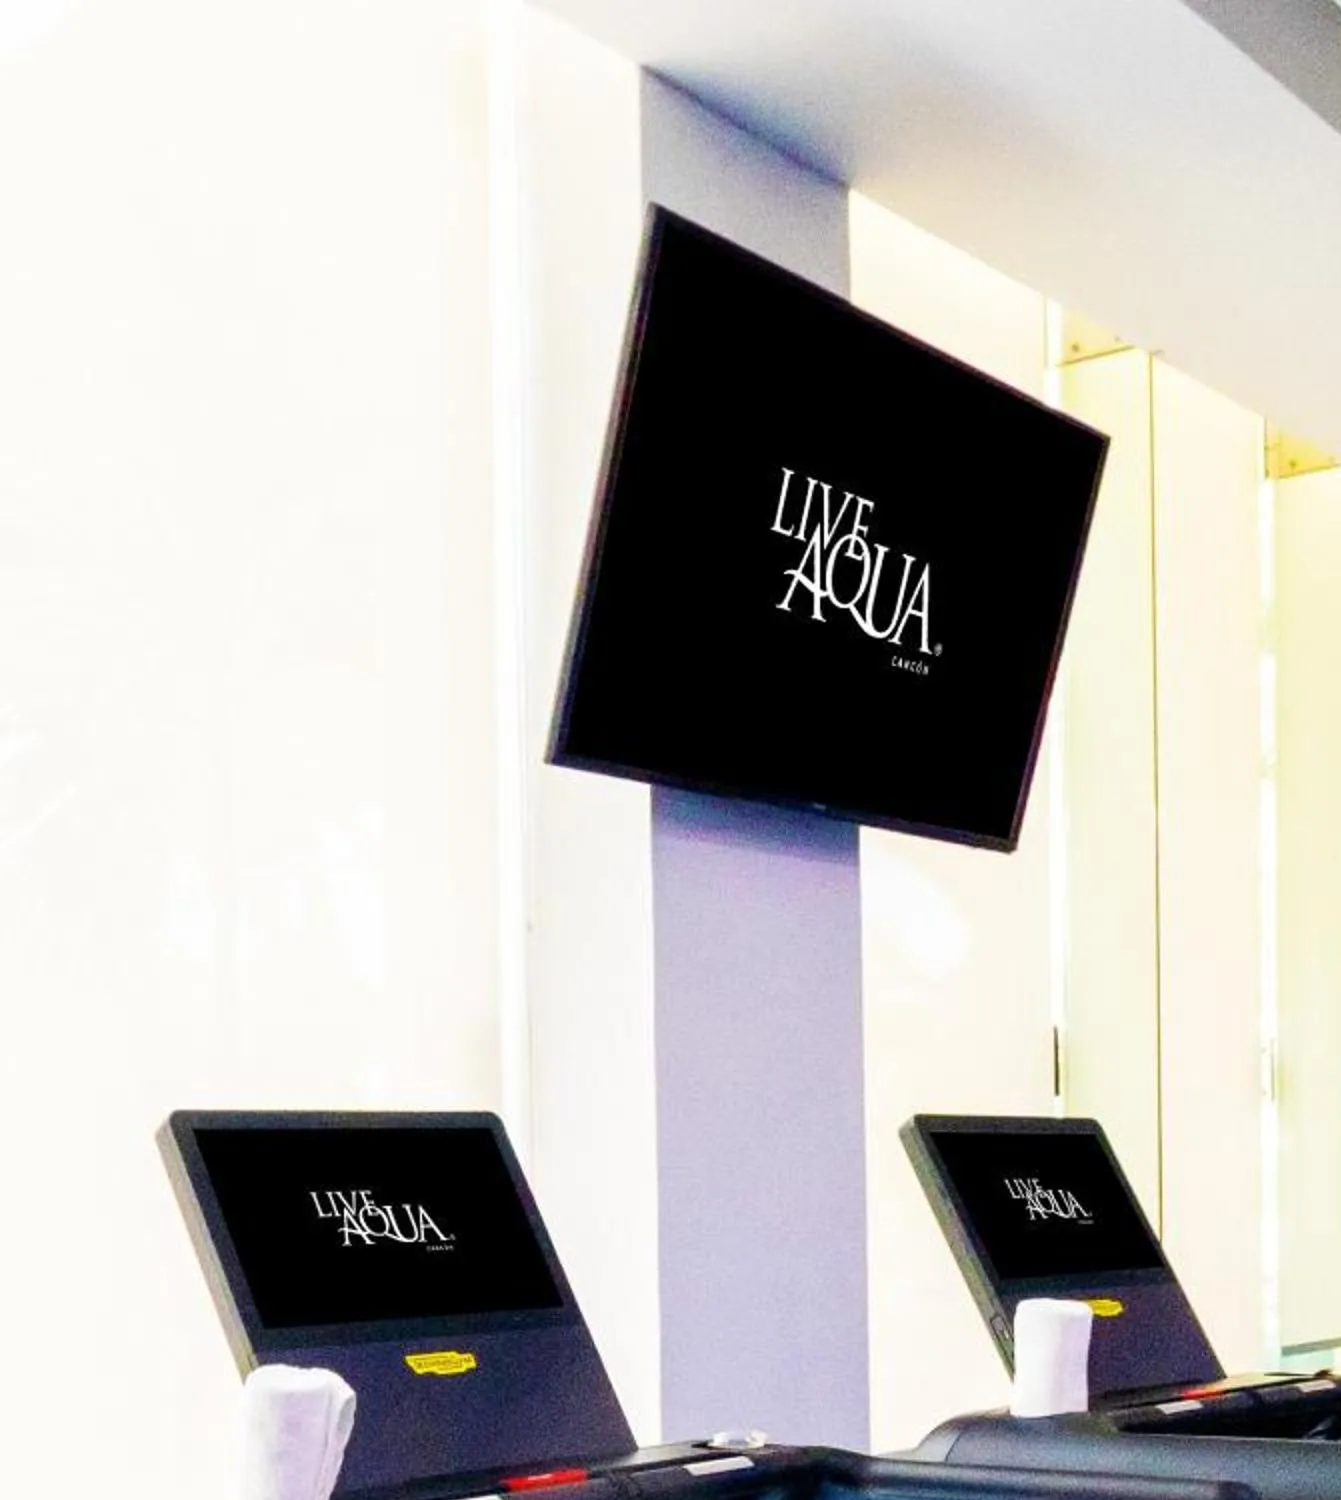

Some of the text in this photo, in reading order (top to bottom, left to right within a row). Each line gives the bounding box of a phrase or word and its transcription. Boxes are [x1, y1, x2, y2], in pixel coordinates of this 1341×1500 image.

[770, 467, 874, 561] LIVE
[310, 1190, 379, 1218] LIVE
[1004, 1178, 1047, 1199] LIVE
[1026, 1189, 1089, 1220] AQUA
[337, 1205, 450, 1247] AQUA
